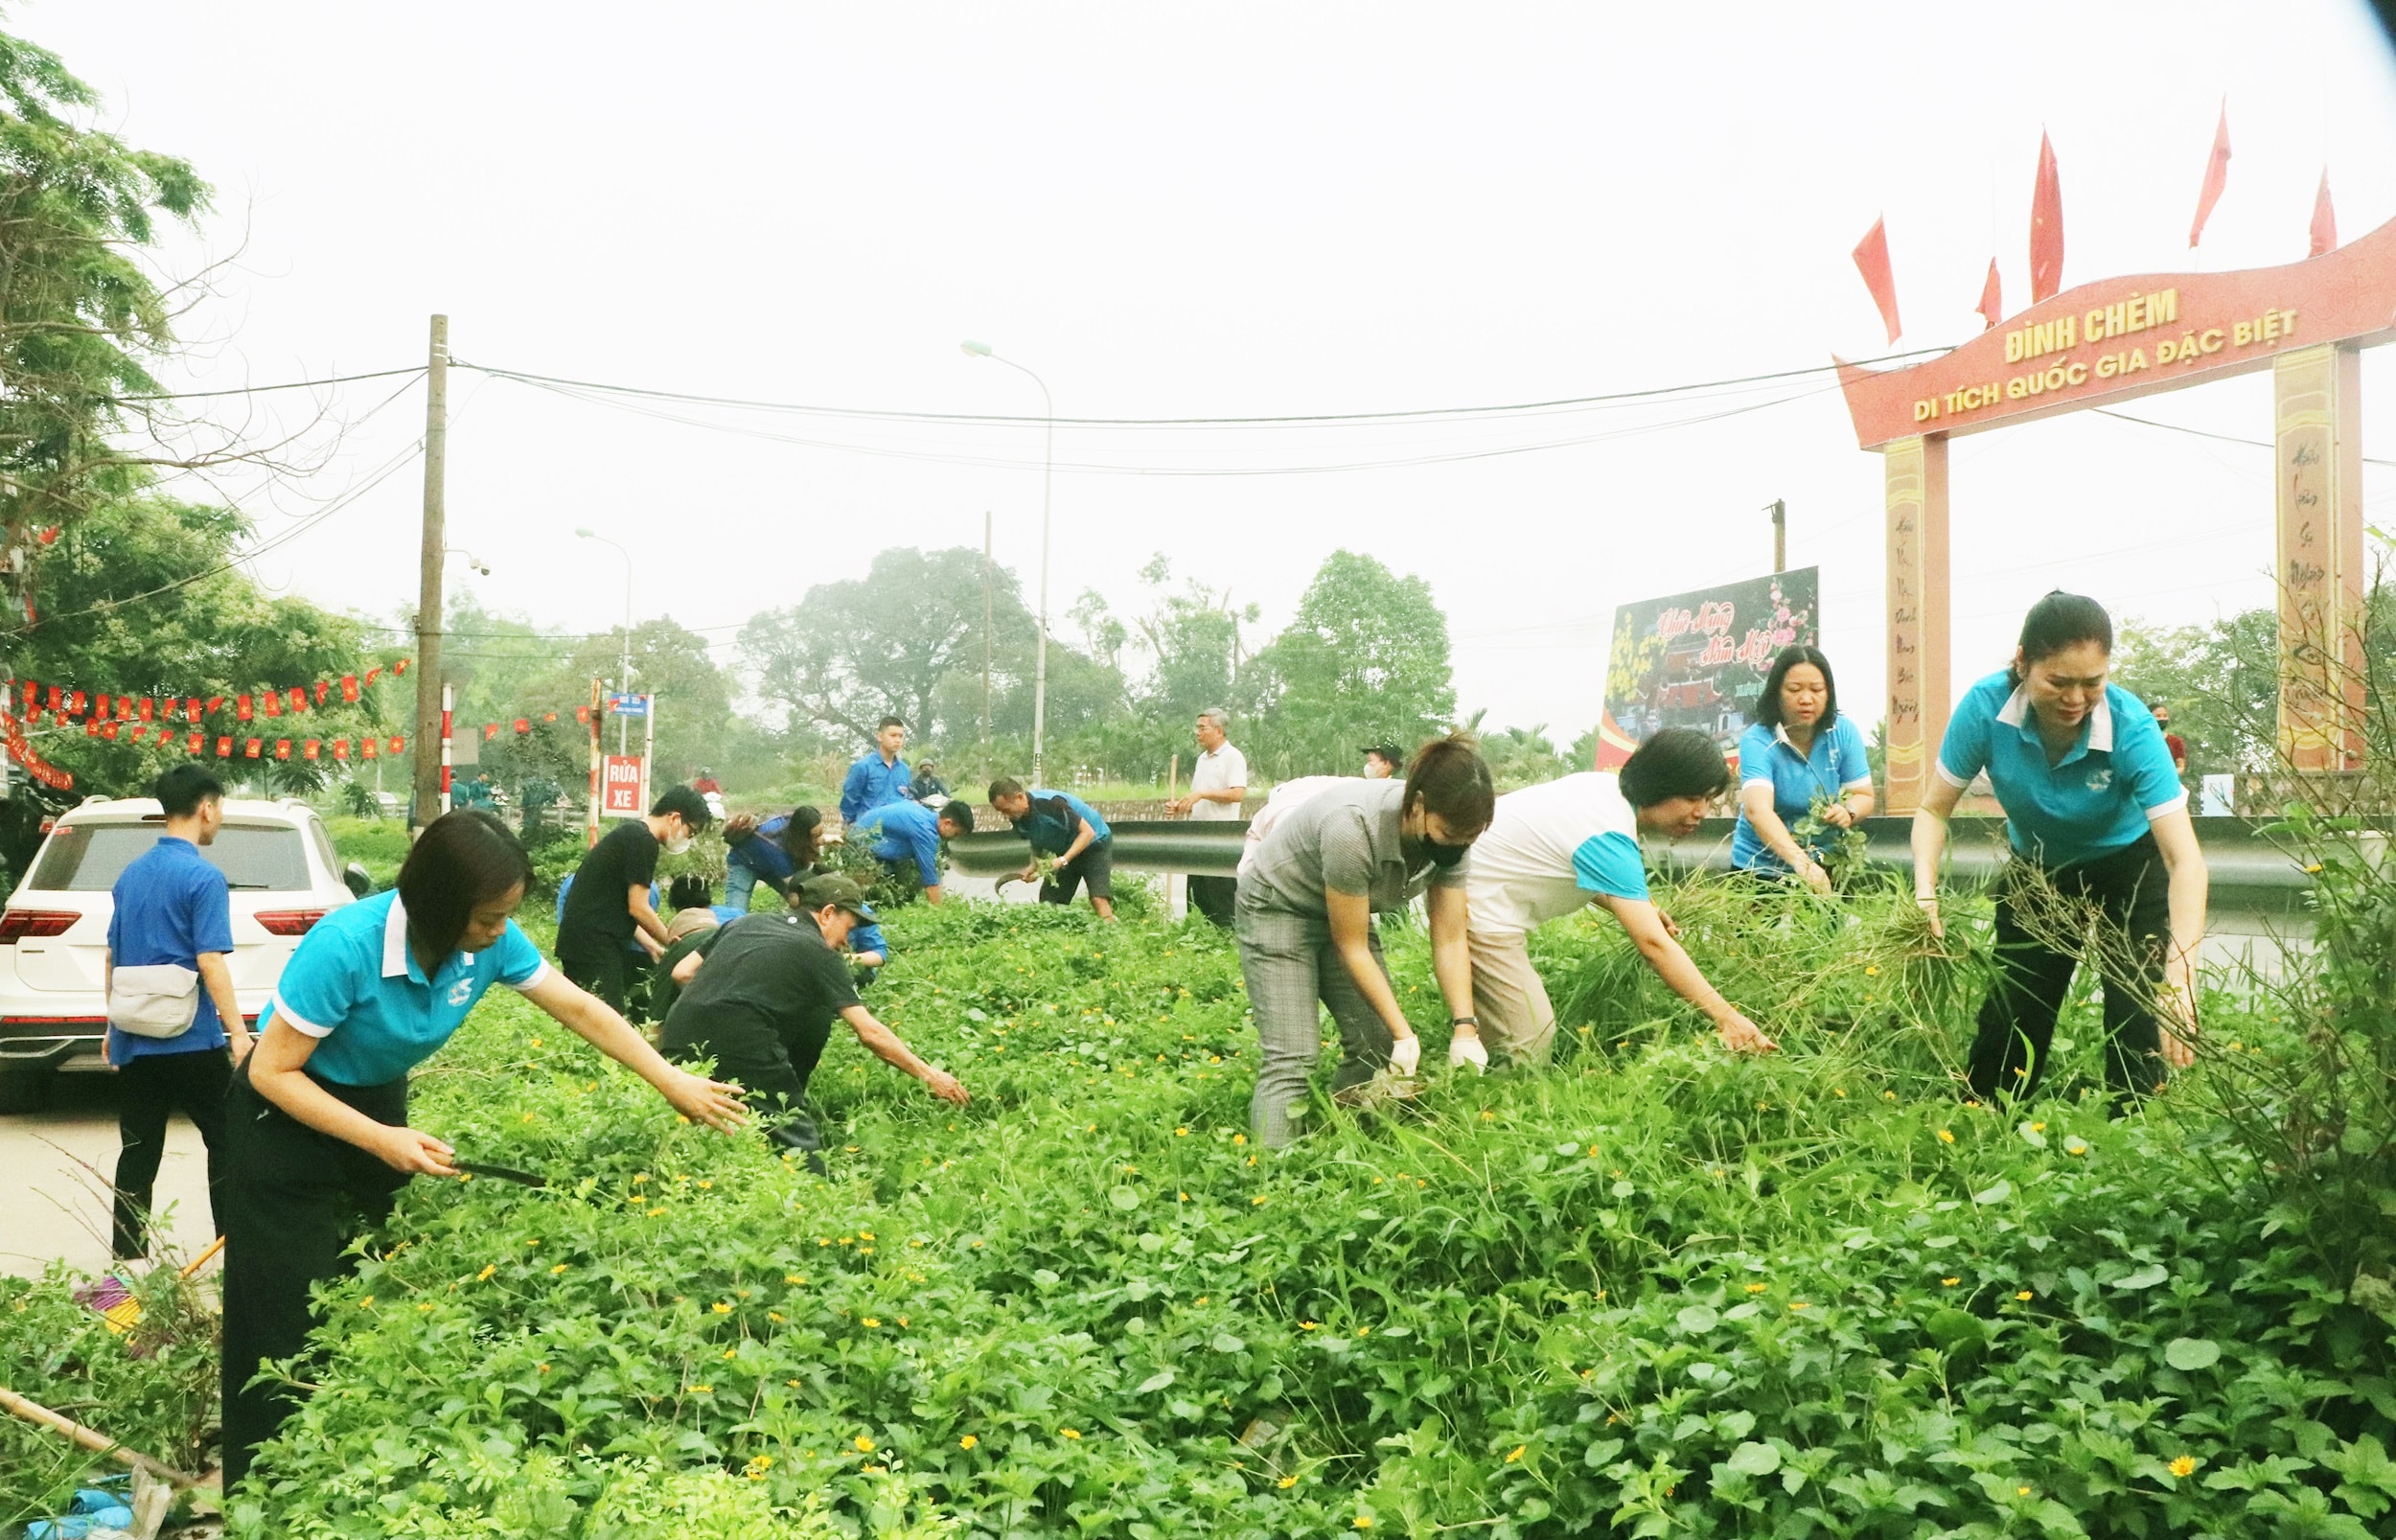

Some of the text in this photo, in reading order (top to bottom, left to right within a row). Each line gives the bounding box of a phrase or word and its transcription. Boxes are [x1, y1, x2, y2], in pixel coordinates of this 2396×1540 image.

[2005, 287, 2178, 363] ĐÌNH CHÈM
[1914, 308, 2297, 422] DI TÍCH QUỐC GIA ĐẶC BIỆT
[610, 759, 638, 783] RỬA
[613, 789, 633, 807] XE
